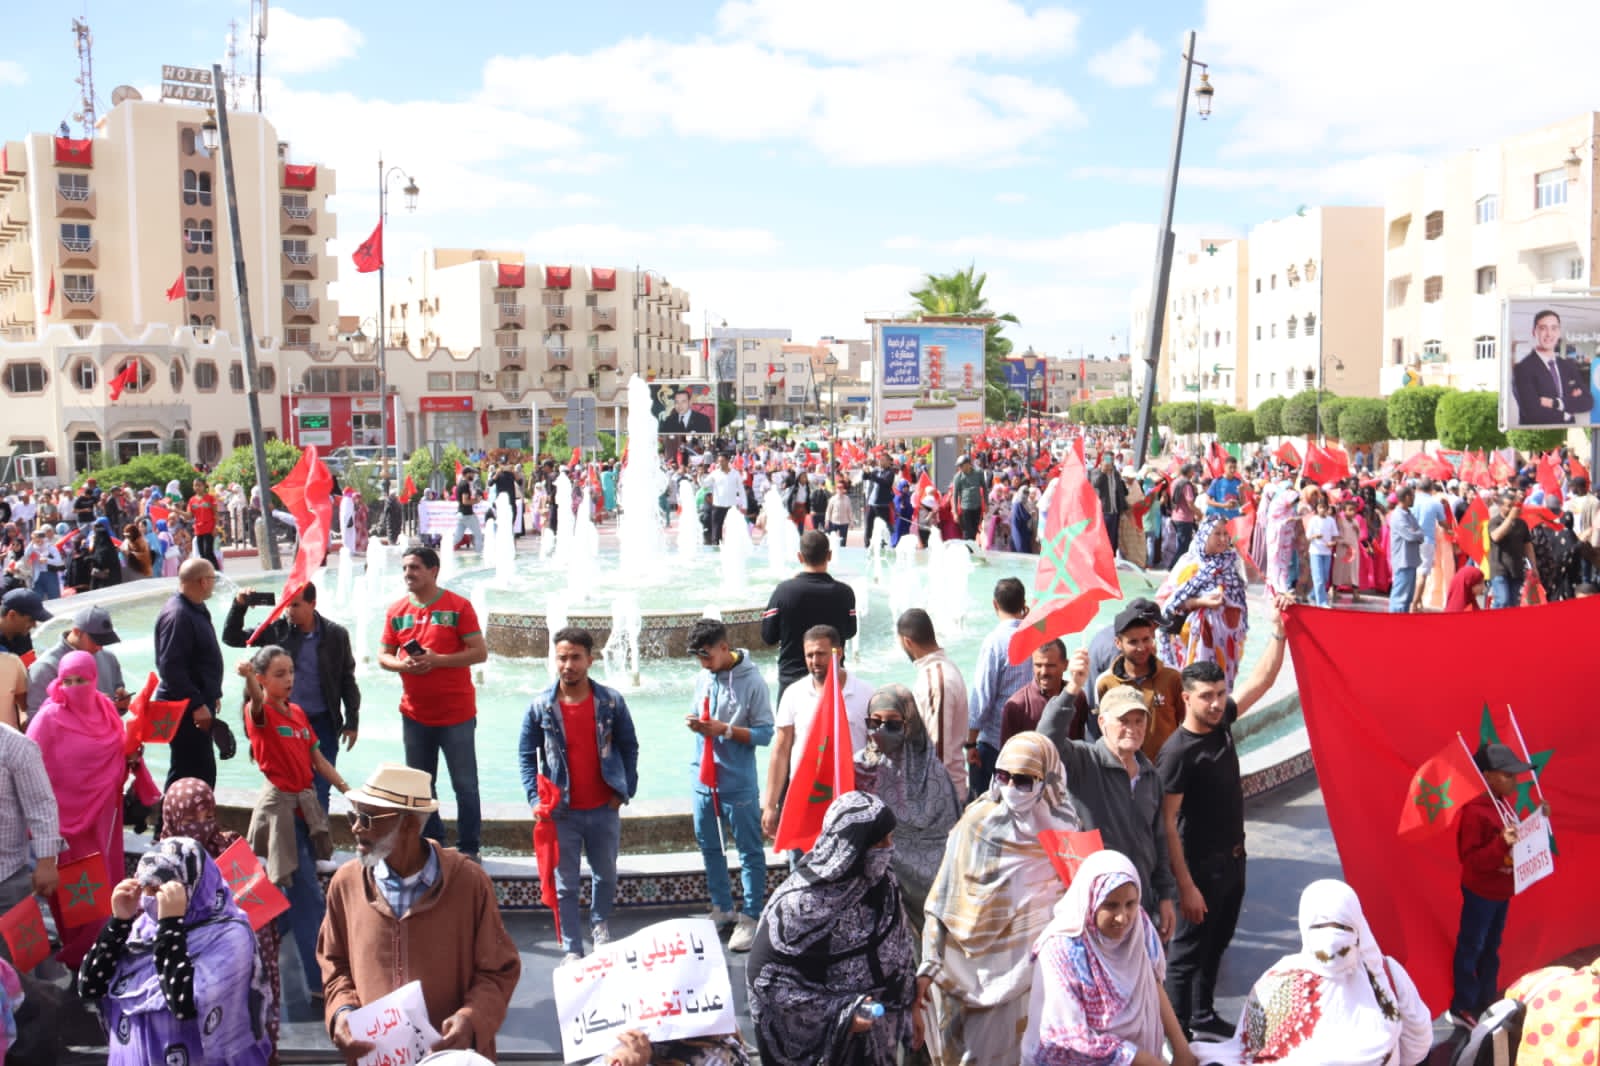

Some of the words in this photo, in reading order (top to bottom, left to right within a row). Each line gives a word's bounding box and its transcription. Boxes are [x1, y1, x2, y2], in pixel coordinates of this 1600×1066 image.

[164, 67, 210, 83] HOTE
[625, 949, 638, 969] يا
[642, 932, 687, 971] غويلي
[690, 931, 705, 960] يا
[685, 988, 724, 1014] عدت
[366, 1008, 402, 1040] التراب
[573, 1002, 633, 1045] السكان
